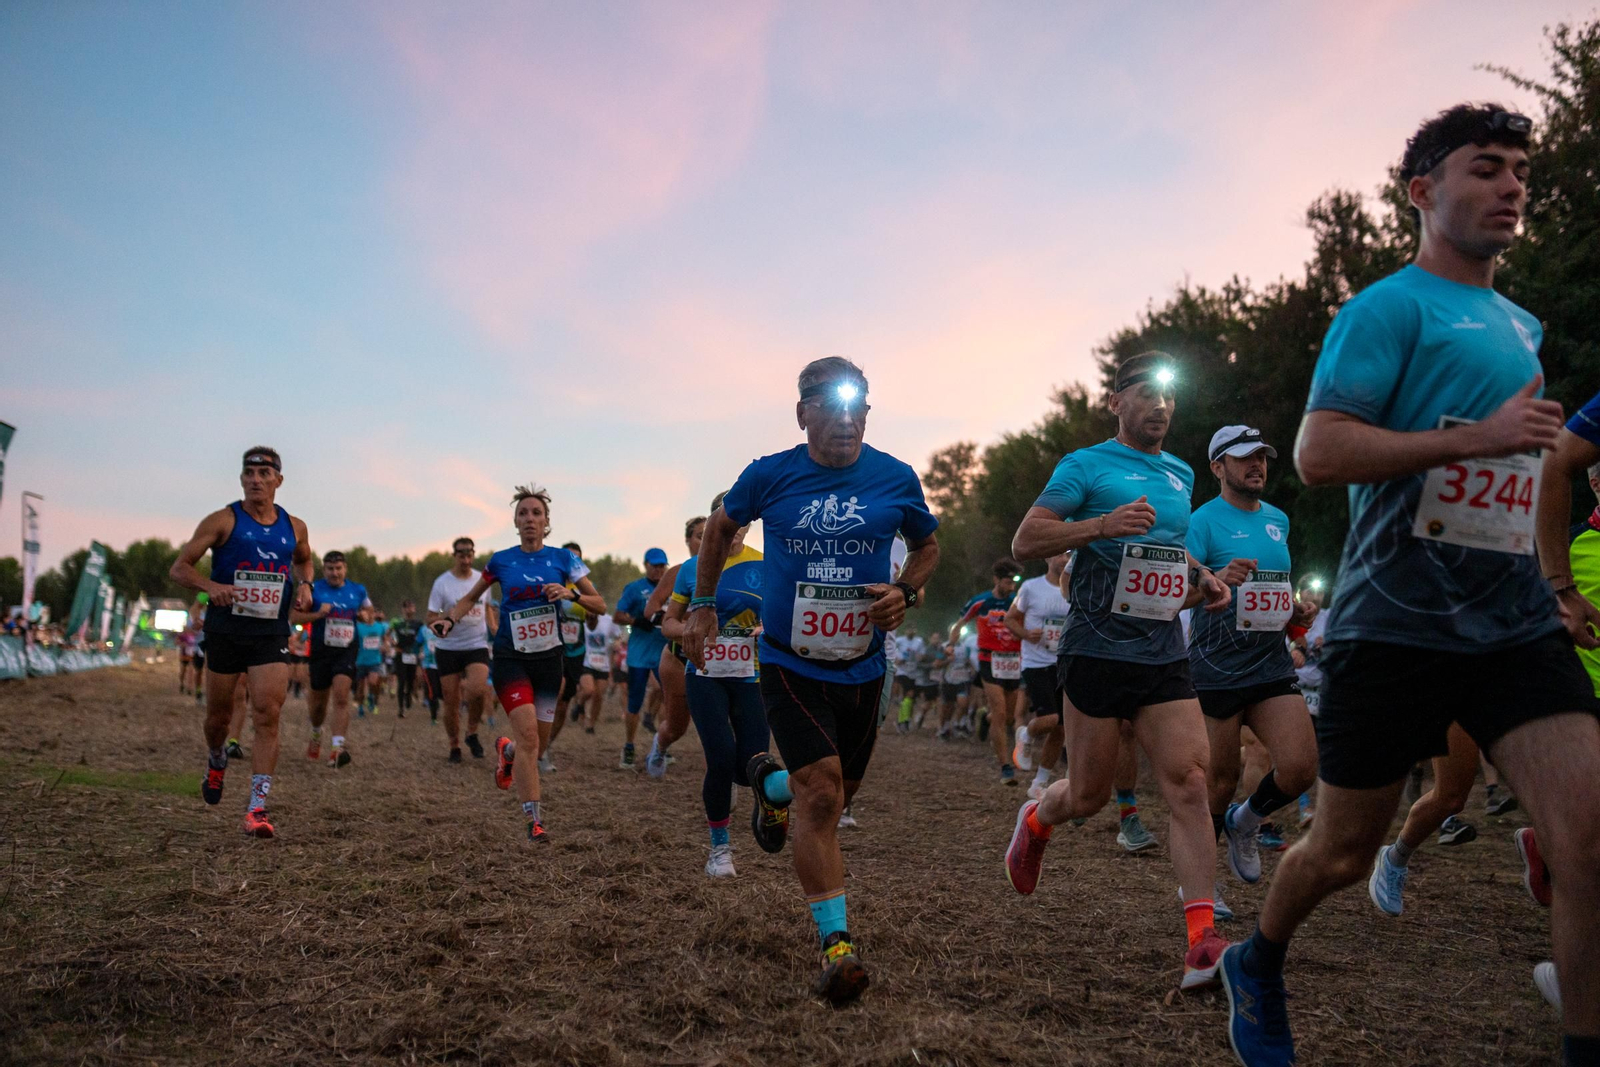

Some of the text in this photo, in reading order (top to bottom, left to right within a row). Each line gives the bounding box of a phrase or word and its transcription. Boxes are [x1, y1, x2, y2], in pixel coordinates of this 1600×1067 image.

[1437, 464, 1535, 516] 3244
[785, 538, 875, 555] TRIATLON
[1147, 549, 1176, 560] ITÁLICA
[806, 567, 853, 579] ORIPPO
[820, 588, 859, 598] ITÁLICA
[1124, 570, 1185, 599] 3093
[238, 588, 280, 604] 3586
[1244, 592, 1290, 612] 3578
[516, 620, 555, 641] 3587
[801, 610, 871, 638] 3042
[704, 644, 751, 662] 3960
[994, 661, 1020, 672] 3560
